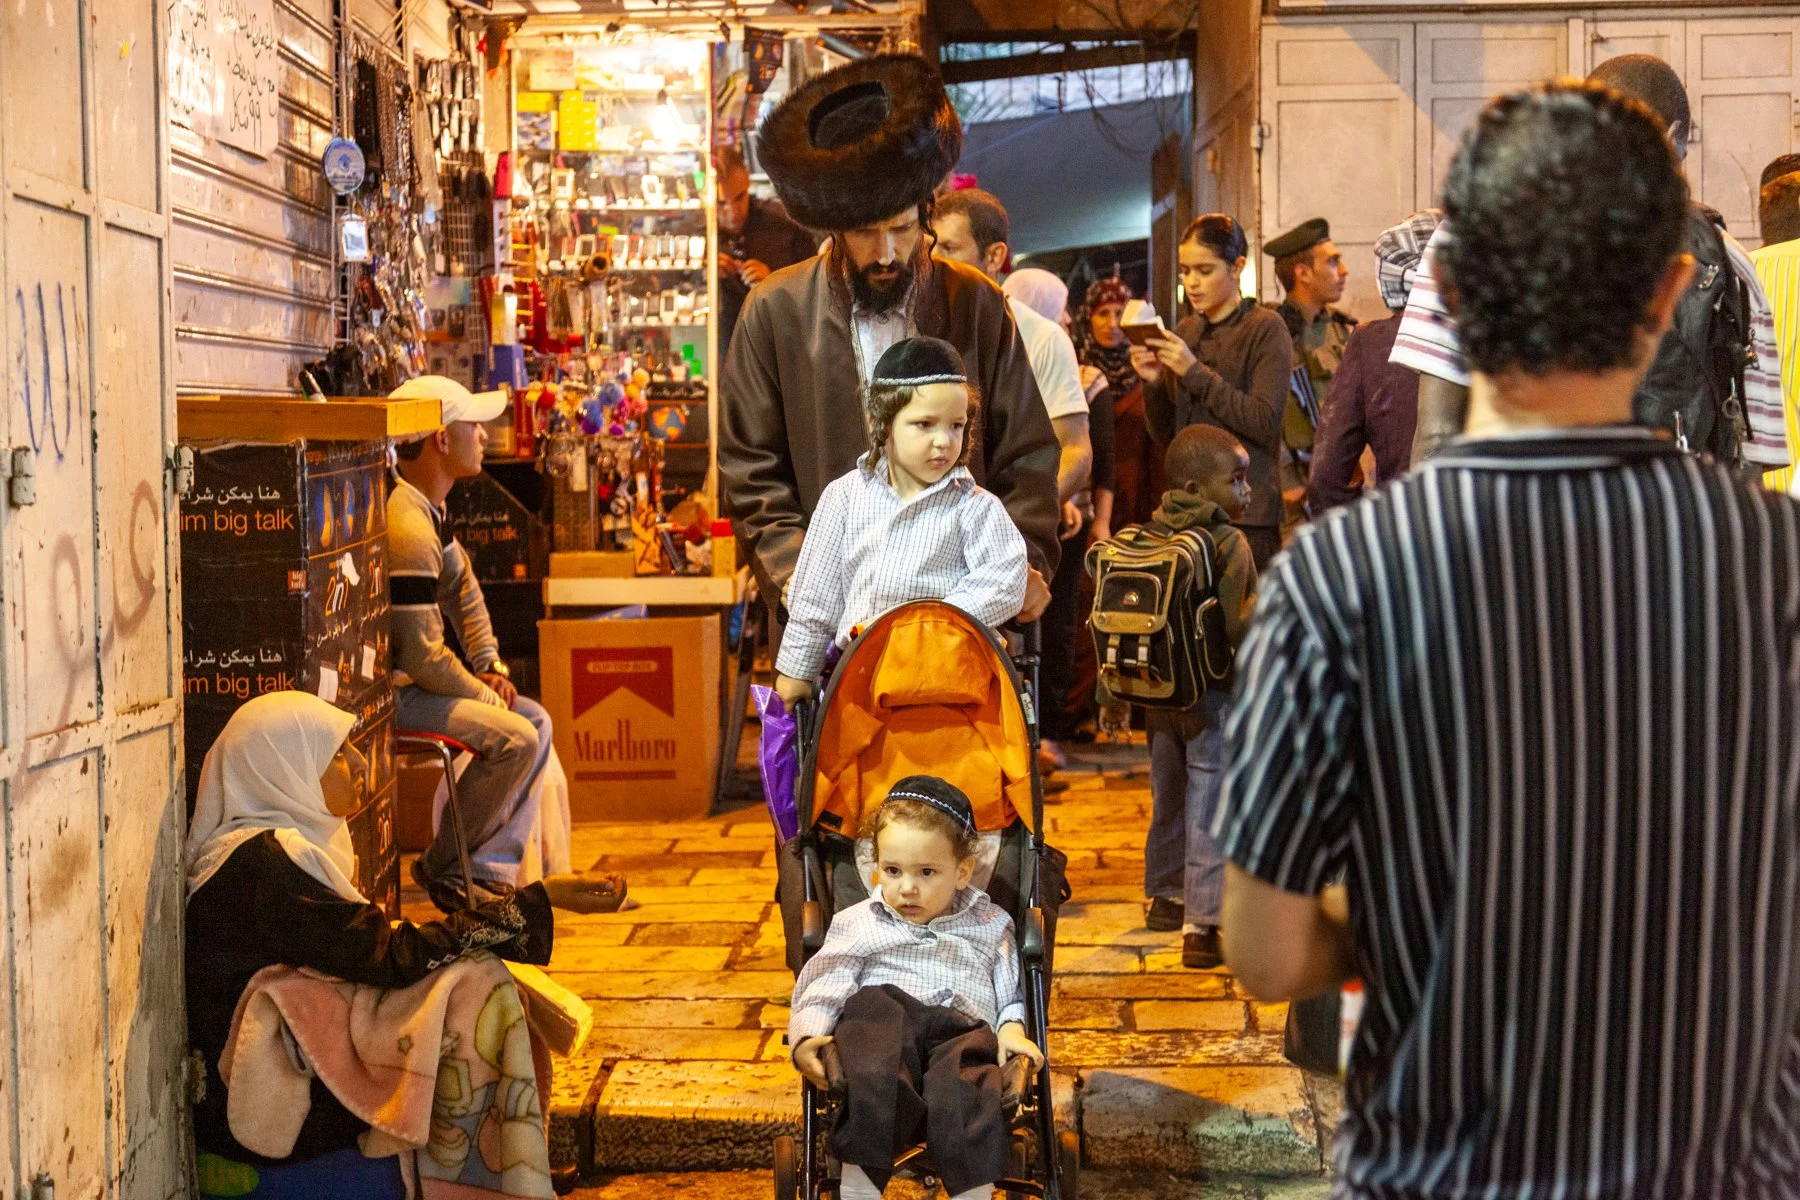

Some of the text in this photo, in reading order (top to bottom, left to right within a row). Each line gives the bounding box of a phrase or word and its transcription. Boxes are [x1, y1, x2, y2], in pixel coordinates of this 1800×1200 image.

[217, 485, 254, 505] يمكن
[258, 485, 281, 500] هنا
[213, 509, 248, 537] big
[255, 508, 295, 532] talk
[219, 648, 255, 668] يمكن
[260, 647, 283, 663] هنا
[215, 672, 250, 699] big
[256, 671, 296, 694] talk
[573, 719, 677, 762] Marlboro
